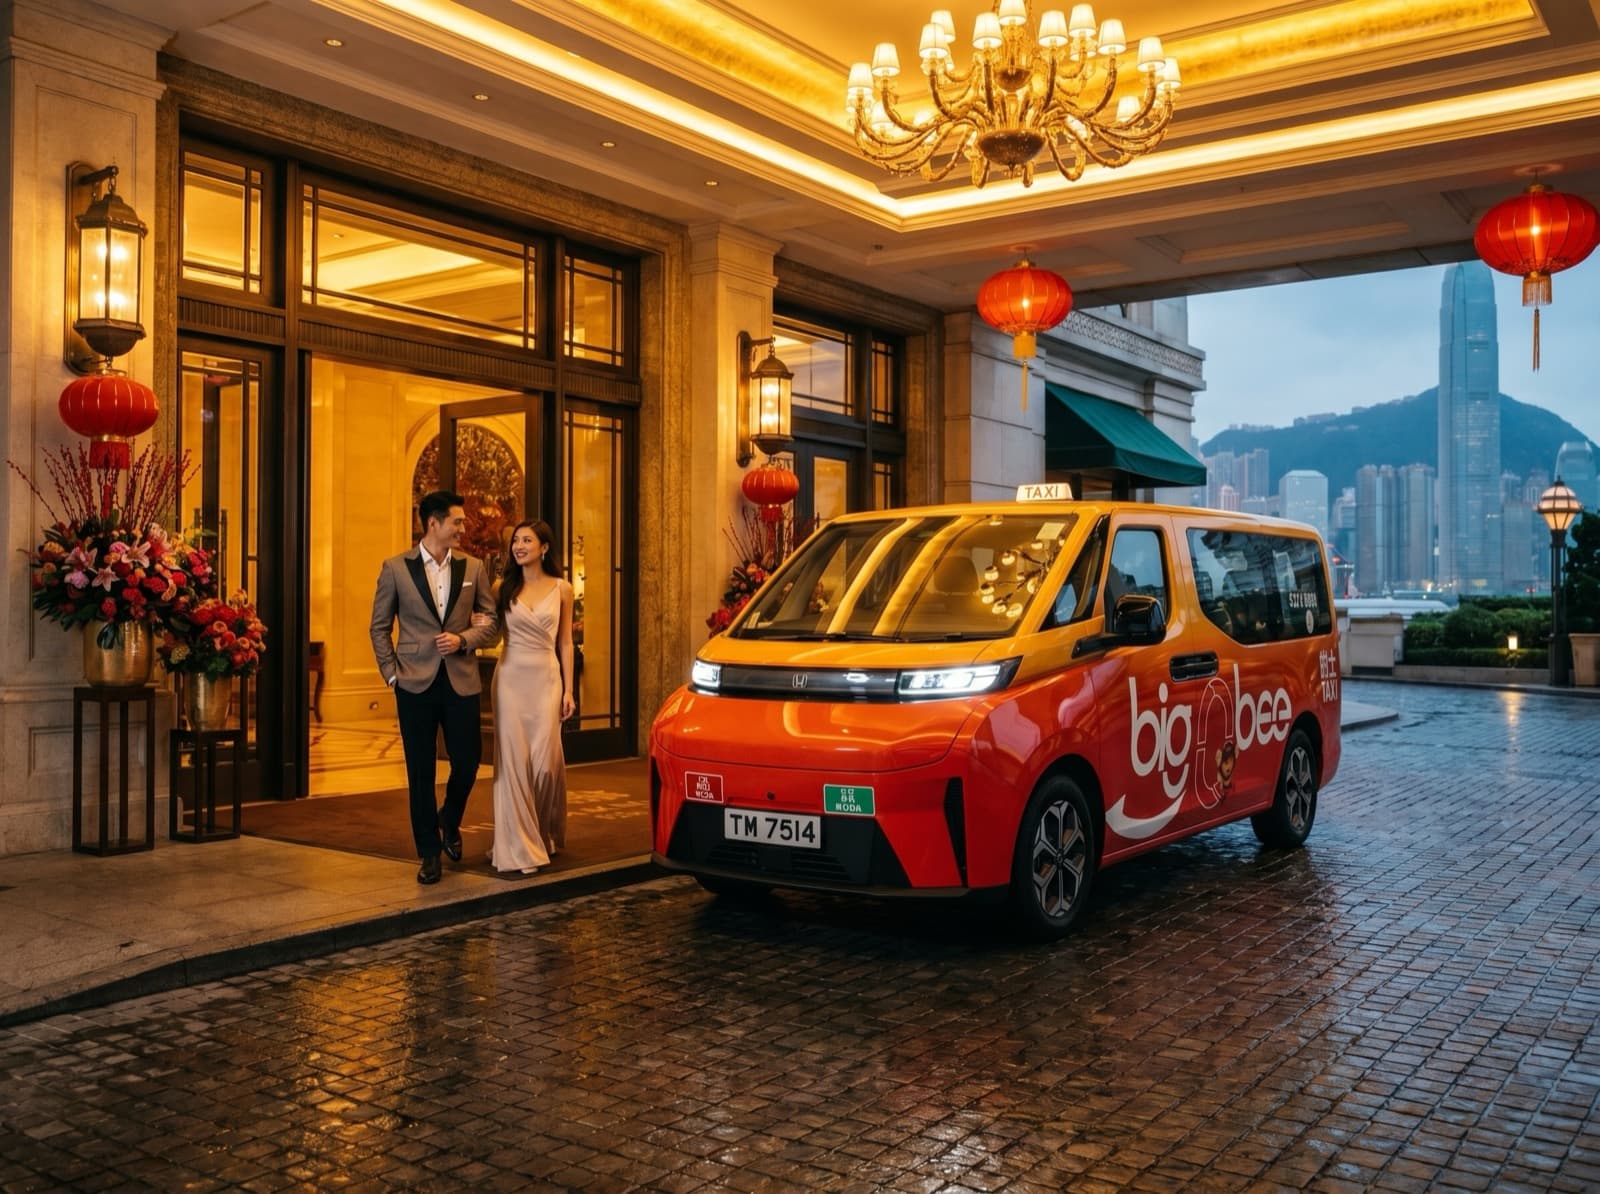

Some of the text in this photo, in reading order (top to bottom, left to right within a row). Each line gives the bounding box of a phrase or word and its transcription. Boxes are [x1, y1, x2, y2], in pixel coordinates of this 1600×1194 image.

[1025, 486, 1059, 499] TAXI
[1321, 679, 1338, 703] TAXI
[1128, 663, 1293, 799] big bee
[729, 813, 815, 843] TM 7514
